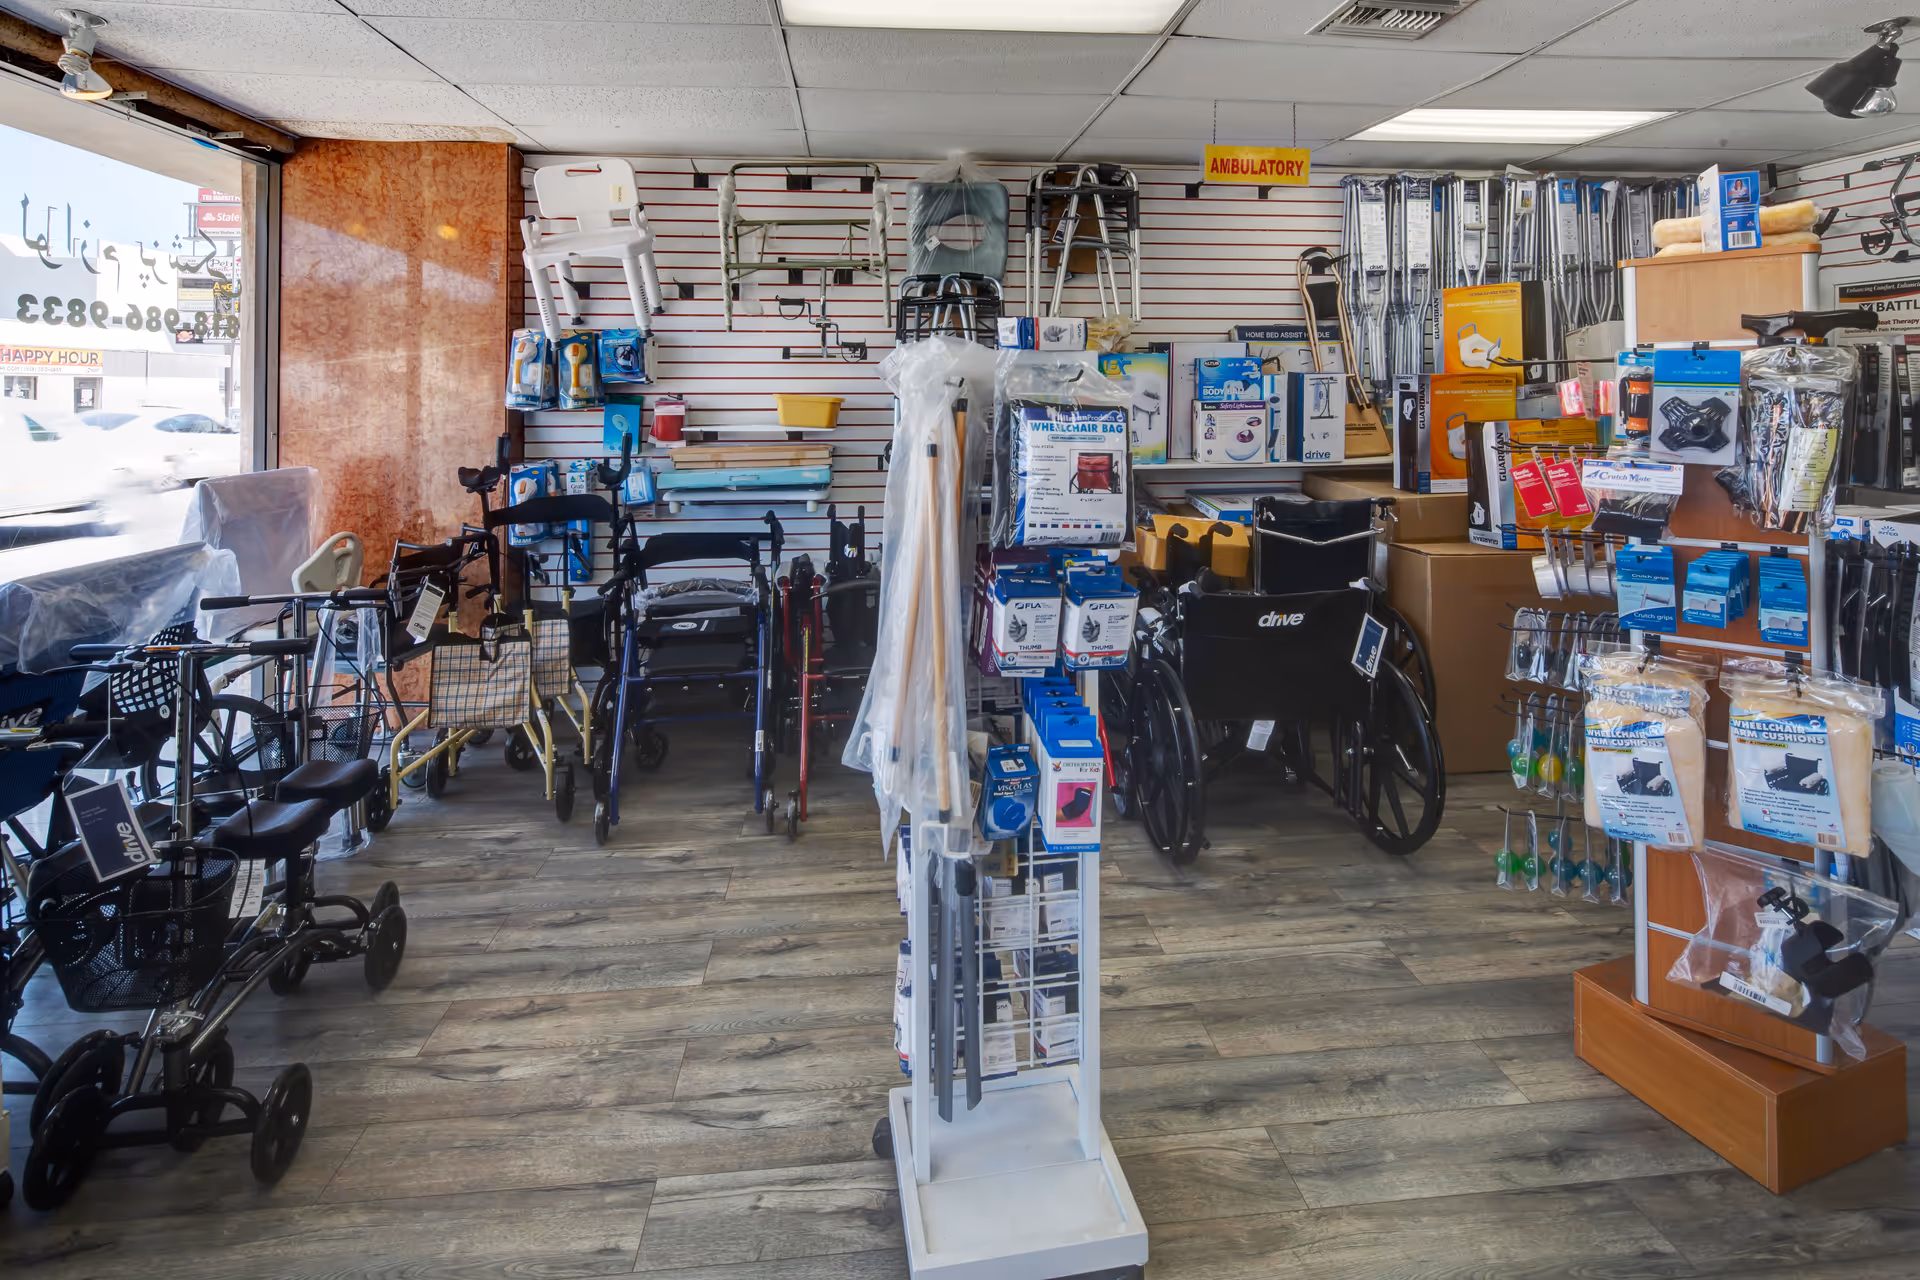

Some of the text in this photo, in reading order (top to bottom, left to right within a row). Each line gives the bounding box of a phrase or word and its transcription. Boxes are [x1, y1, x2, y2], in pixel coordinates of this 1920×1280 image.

[1210, 157, 1305, 176] AMBULATORY
[216, 212, 240, 221] State
[1, 349, 99, 365] HAPPY HOUR
[1203, 388, 1224, 396] BODY
[1030, 422, 1123, 433] WHEELCHAIR BAG
[1304, 450, 1331, 459] drive
[1599, 471, 1628, 481] Crutch
[1473, 535, 1499, 545] GUARDIAN
[1258, 611, 1304, 627] drive
[1366, 645, 1377, 672] drive
[1732, 719, 1806, 734] WHEELCHAIR
[1586, 729, 1647, 739] WHEELCHAIR
[1733, 727, 1826, 745] ARM CUSHIONS
[1588, 738, 1665, 748] ARM CUSHIONS
[116, 821, 146, 863] drive
